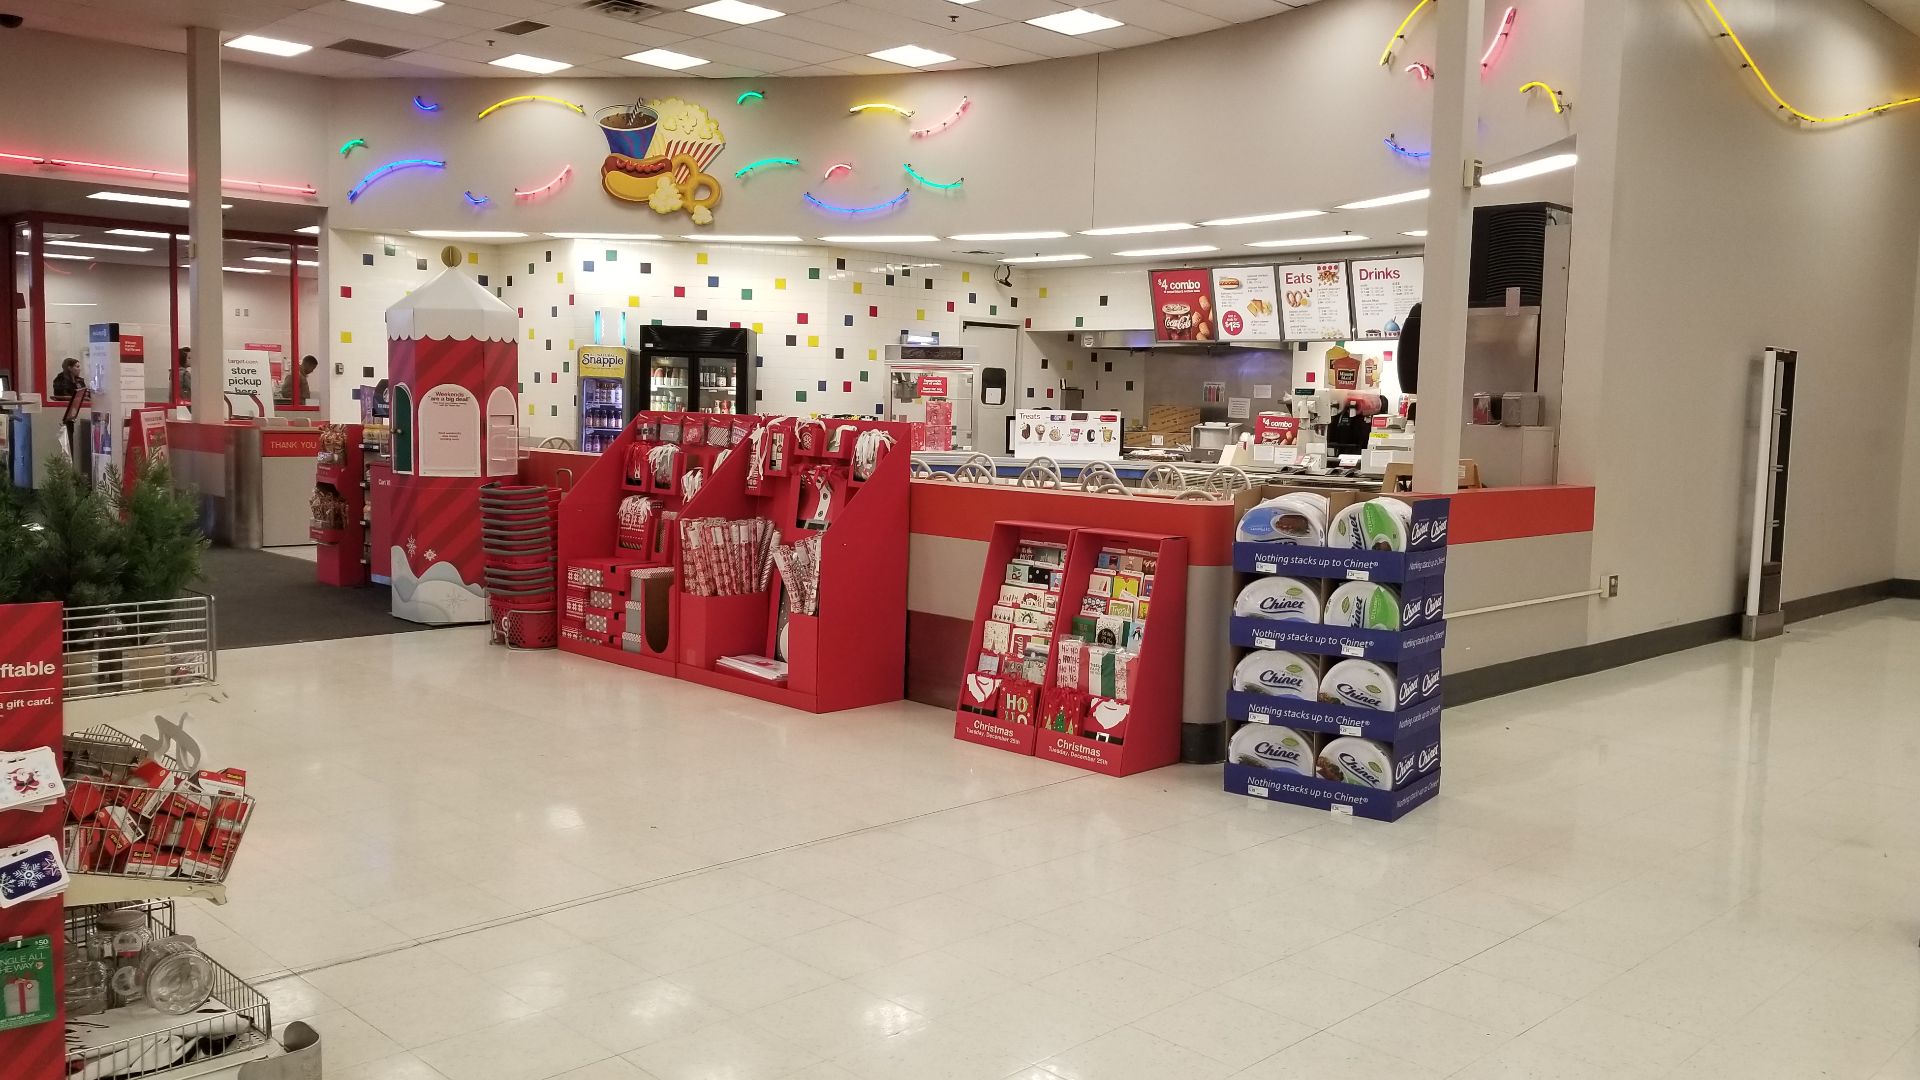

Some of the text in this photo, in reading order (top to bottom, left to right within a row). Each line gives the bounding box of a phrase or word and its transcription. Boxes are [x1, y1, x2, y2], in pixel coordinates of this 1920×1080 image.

[1285, 272, 1313, 285] Eats
[1359, 267, 1401, 281] Drinks
[1158, 279, 1201, 290] $4 combo
[581, 353, 624, 368] Snapple
[231, 367, 257, 375] store
[228, 377, 262, 387] pickup
[1262, 418, 1293, 428] $4 combo
[271, 441, 317, 449] THANK YOU
[1349, 513, 1363, 550] hinet
[1254, 552, 1289, 565] Nothing
[1290, 556, 1317, 566] stacks
[1319, 558, 1330, 568] up
[1331, 558, 1342, 567] to
[1259, 596, 1306, 610] Chinet
[1251, 628, 1286, 642] Nothing
[1286, 632, 1313, 642] stacks
[1315, 636, 1326, 646] up
[1328, 636, 1338, 645] to
[0, 660, 56, 678] ftable
[1259, 669, 1304, 686] Chinet
[6, 700, 25, 710] gift
[27, 696, 54, 707] card.
[1006, 693, 1028, 713] HO
[1336, 683, 1382, 707] Chinet
[1248, 703, 1283, 717] Nothing
[1283, 708, 1310, 720] stacks
[1311, 713, 1323, 723] up
[1324, 713, 1334, 723] to
[966, 727, 986, 737] Tuesday,
[986, 731, 1009, 743] December
[973, 720, 1014, 737] Christmas
[1056, 738, 1101, 757] Christmas
[1254, 741, 1301, 761] Chinet
[1048, 746, 1108, 766] Tuesday, December 25th
[1418, 744, 1439, 769] Chinet
[1338, 752, 1381, 785] Chinet
[1247, 776, 1281, 791] Nothing
[1282, 781, 1308, 795] stacks
[1309, 788, 1321, 799] up
[1323, 789, 1332, 799] to
[35, 939, 49, 947] $50
[29, 952, 47, 961] ALL
[0, 962, 35, 974] HE WAY
